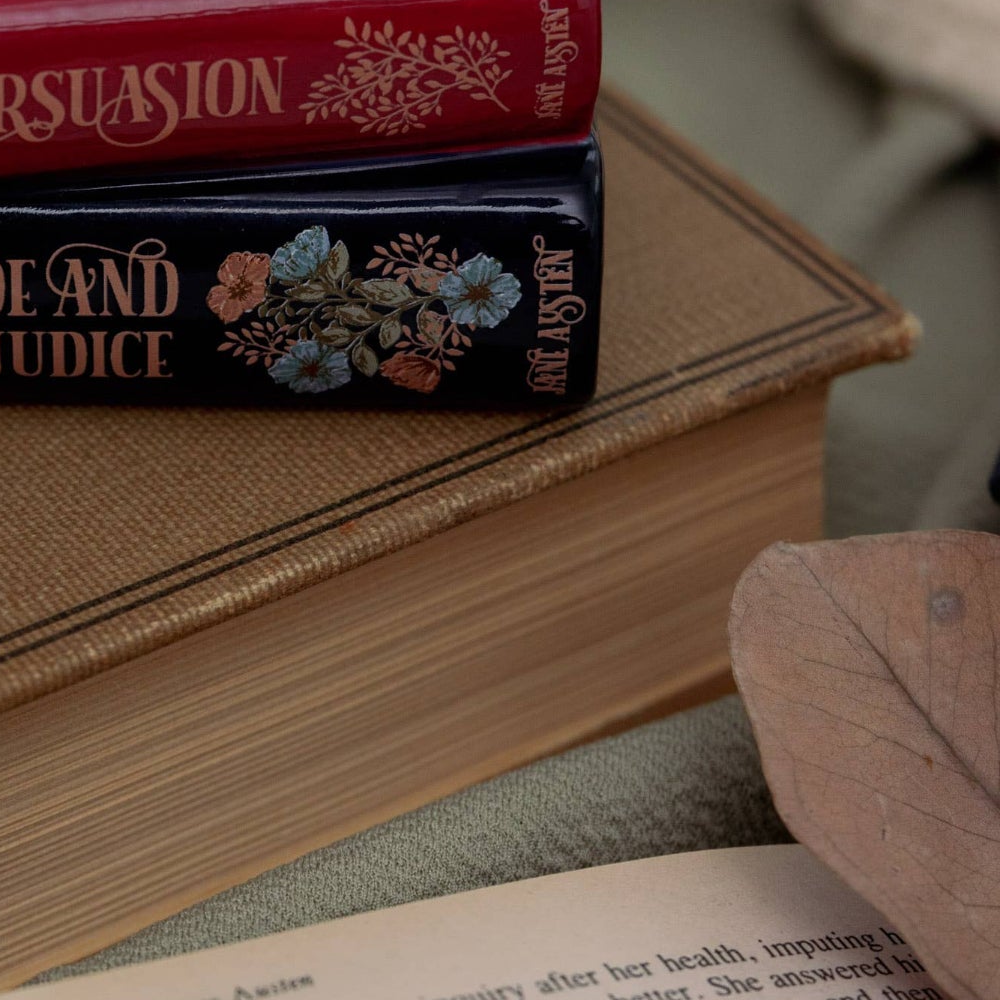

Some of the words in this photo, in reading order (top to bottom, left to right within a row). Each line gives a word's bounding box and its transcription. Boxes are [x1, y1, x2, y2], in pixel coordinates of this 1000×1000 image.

[533, 81, 566, 119] JANE
[45, 238, 180, 318] AND
[532, 234, 586, 344] AUSTEN
[526, 347, 569, 395] JANE
[535, 971, 600, 995] after
[603, 962, 653, 982] her
[656, 944, 758, 973] health,
[757, 930, 884, 961] imputing
[706, 975, 764, 997] She
[769, 956, 894, 989] answered
